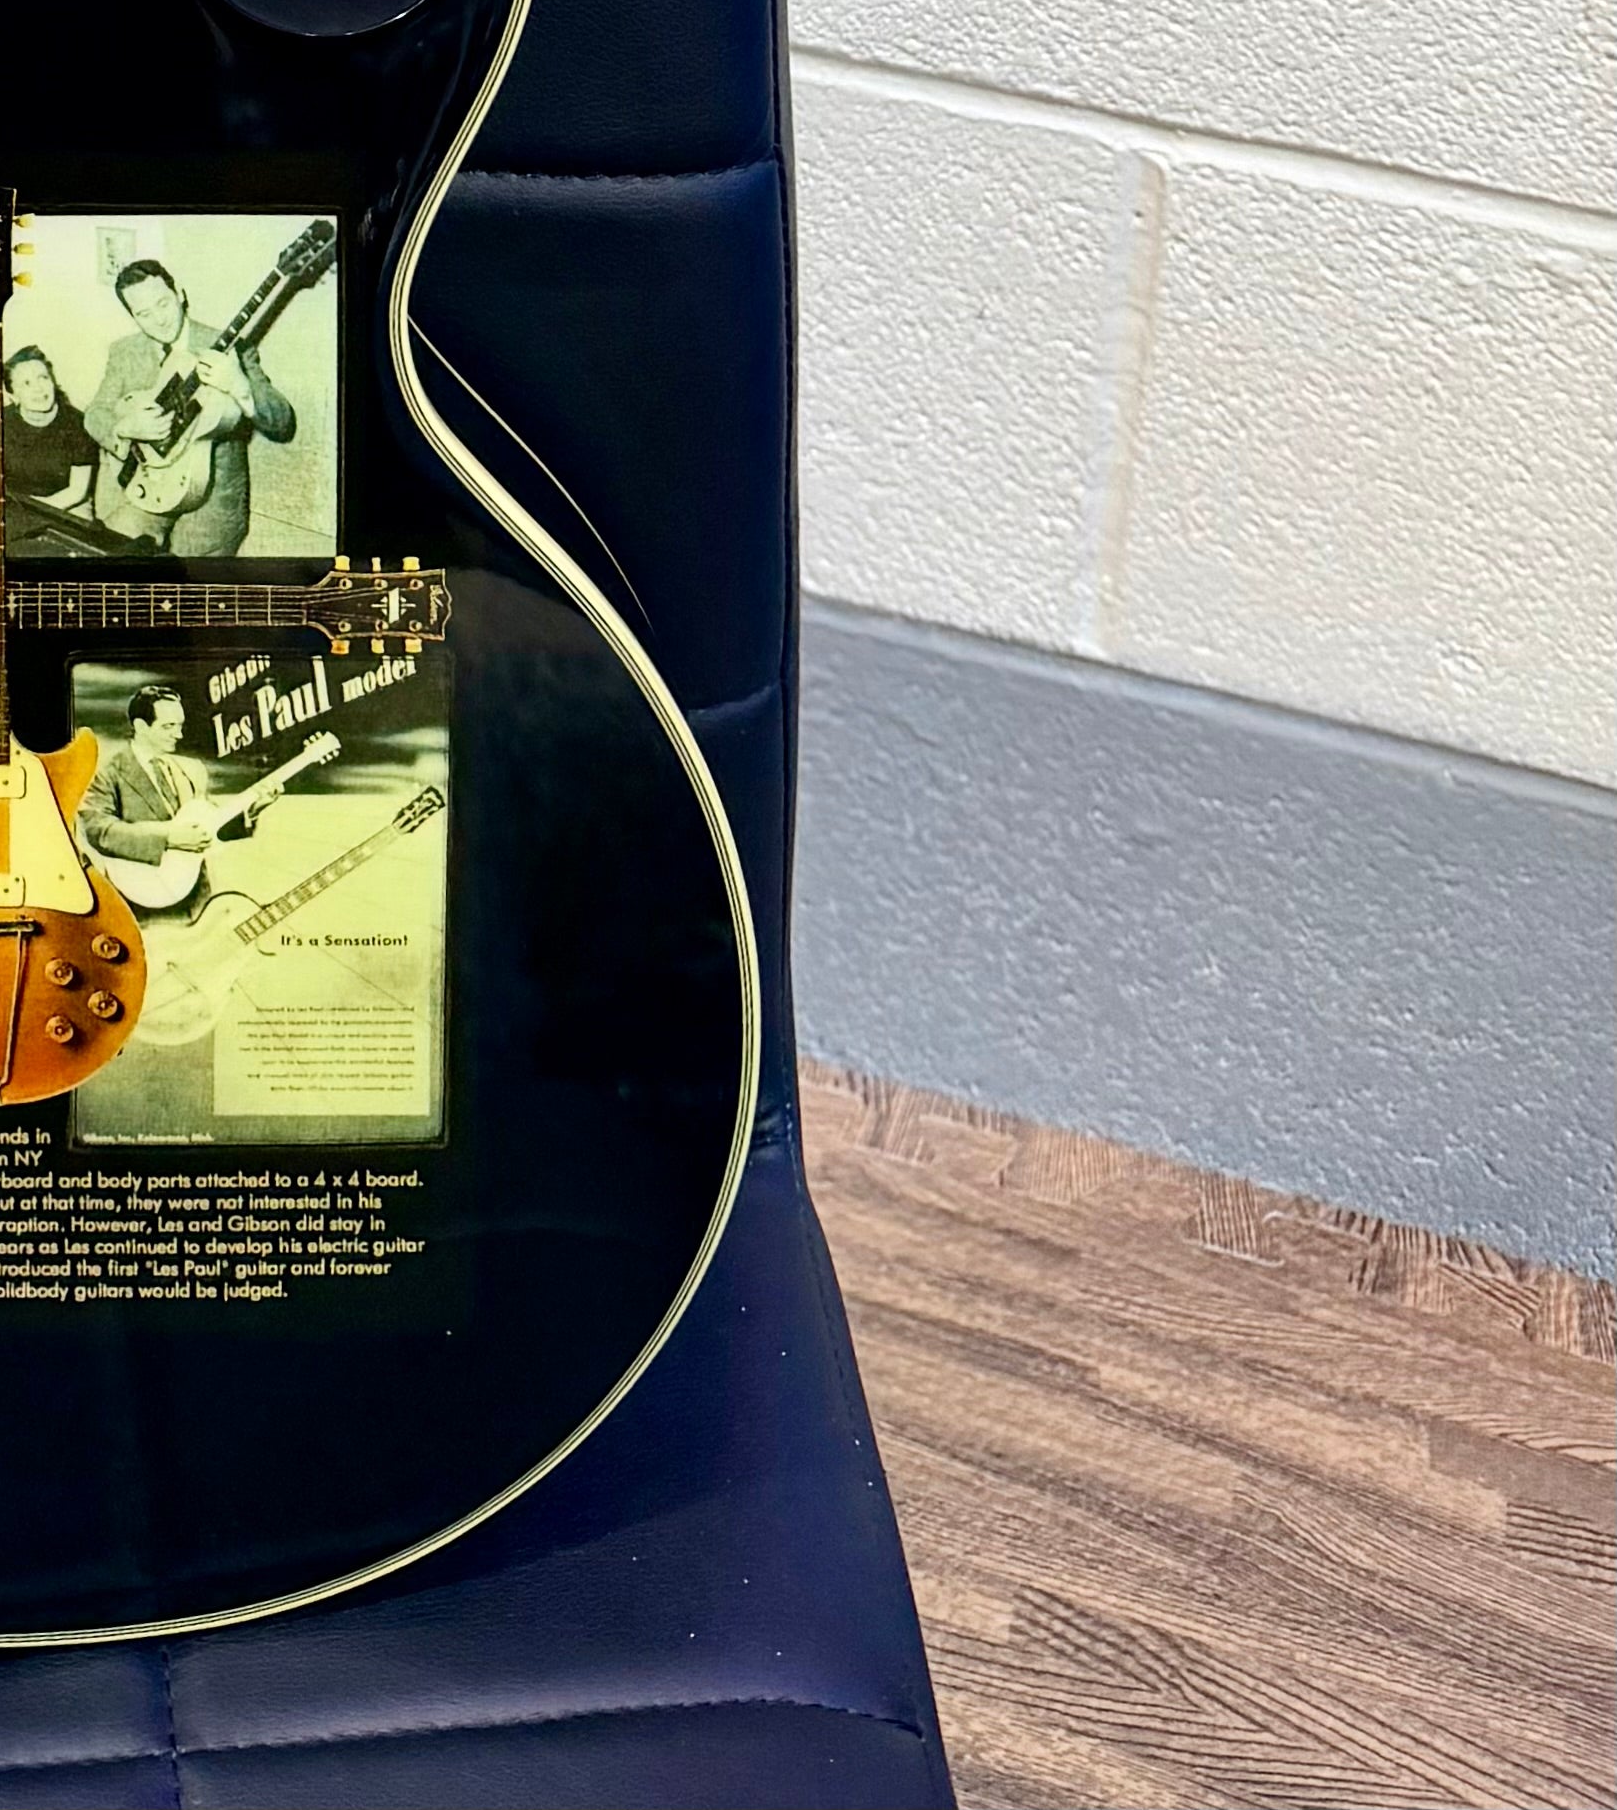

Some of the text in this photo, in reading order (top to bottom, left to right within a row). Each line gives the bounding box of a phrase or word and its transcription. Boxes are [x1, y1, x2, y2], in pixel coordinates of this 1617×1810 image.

[212, 655, 417, 758] Les Paul model
[309, 938, 319, 946] a
[324, 933, 408, 946] Sensation!
[35, 1127, 52, 1145] in
[14, 1149, 43, 1167] NY
[58, 1170, 93, 1189] and
[97, 1170, 143, 1192] body
[147, 1174, 192, 1192] parts
[194, 1170, 271, 1189] attached
[274, 1172, 292, 1188] to
[296, 1175, 309, 1188] a
[313, 1170, 327, 1187] 4
[332, 1175, 343, 1187] x
[347, 1170, 360, 1187] 4
[365, 1169, 424, 1188] board.
[19, 1195, 38, 1211] at
[41, 1192, 75, 1211] that
[78, 1194, 122, 1213] time,
[126, 1192, 163, 1214] they
[167, 1198, 210, 1211] were
[216, 1194, 244, 1210] not
[248, 1191, 331, 1210] interested
[336, 1192, 353, 1210] in
[358, 1190, 383, 1210] his
[70, 1216, 153, 1235] However,
[157, 1215, 185, 1233] Les
[187, 1214, 223, 1233] and
[227, 1214, 291, 1232] Gibson
[295, 1213, 325, 1232] did
[329, 1216, 364, 1235] stay
[369, 1214, 386, 1231] in
[38, 1242, 59, 1255] as
[64, 1237, 90, 1255] Les
[94, 1236, 178, 1255] continued
[183, 1240, 201, 1255] to
[204, 1236, 274, 1258] develop
[278, 1236, 303, 1254] his
[306, 1235, 369, 1254] electric
[372, 1236, 426, 1258] guitar
[76, 1258, 102, 1277] the
[107, 1258, 139, 1277] first
[234, 1259, 287, 1280] guitar
[290, 1257, 326, 1276] and
[329, 1257, 392, 1276] forever
[73, 1282, 134, 1302] guitars
[137, 1280, 191, 1299] would
[195, 1280, 218, 1299] be
[223, 1279, 288, 1302] judged.
